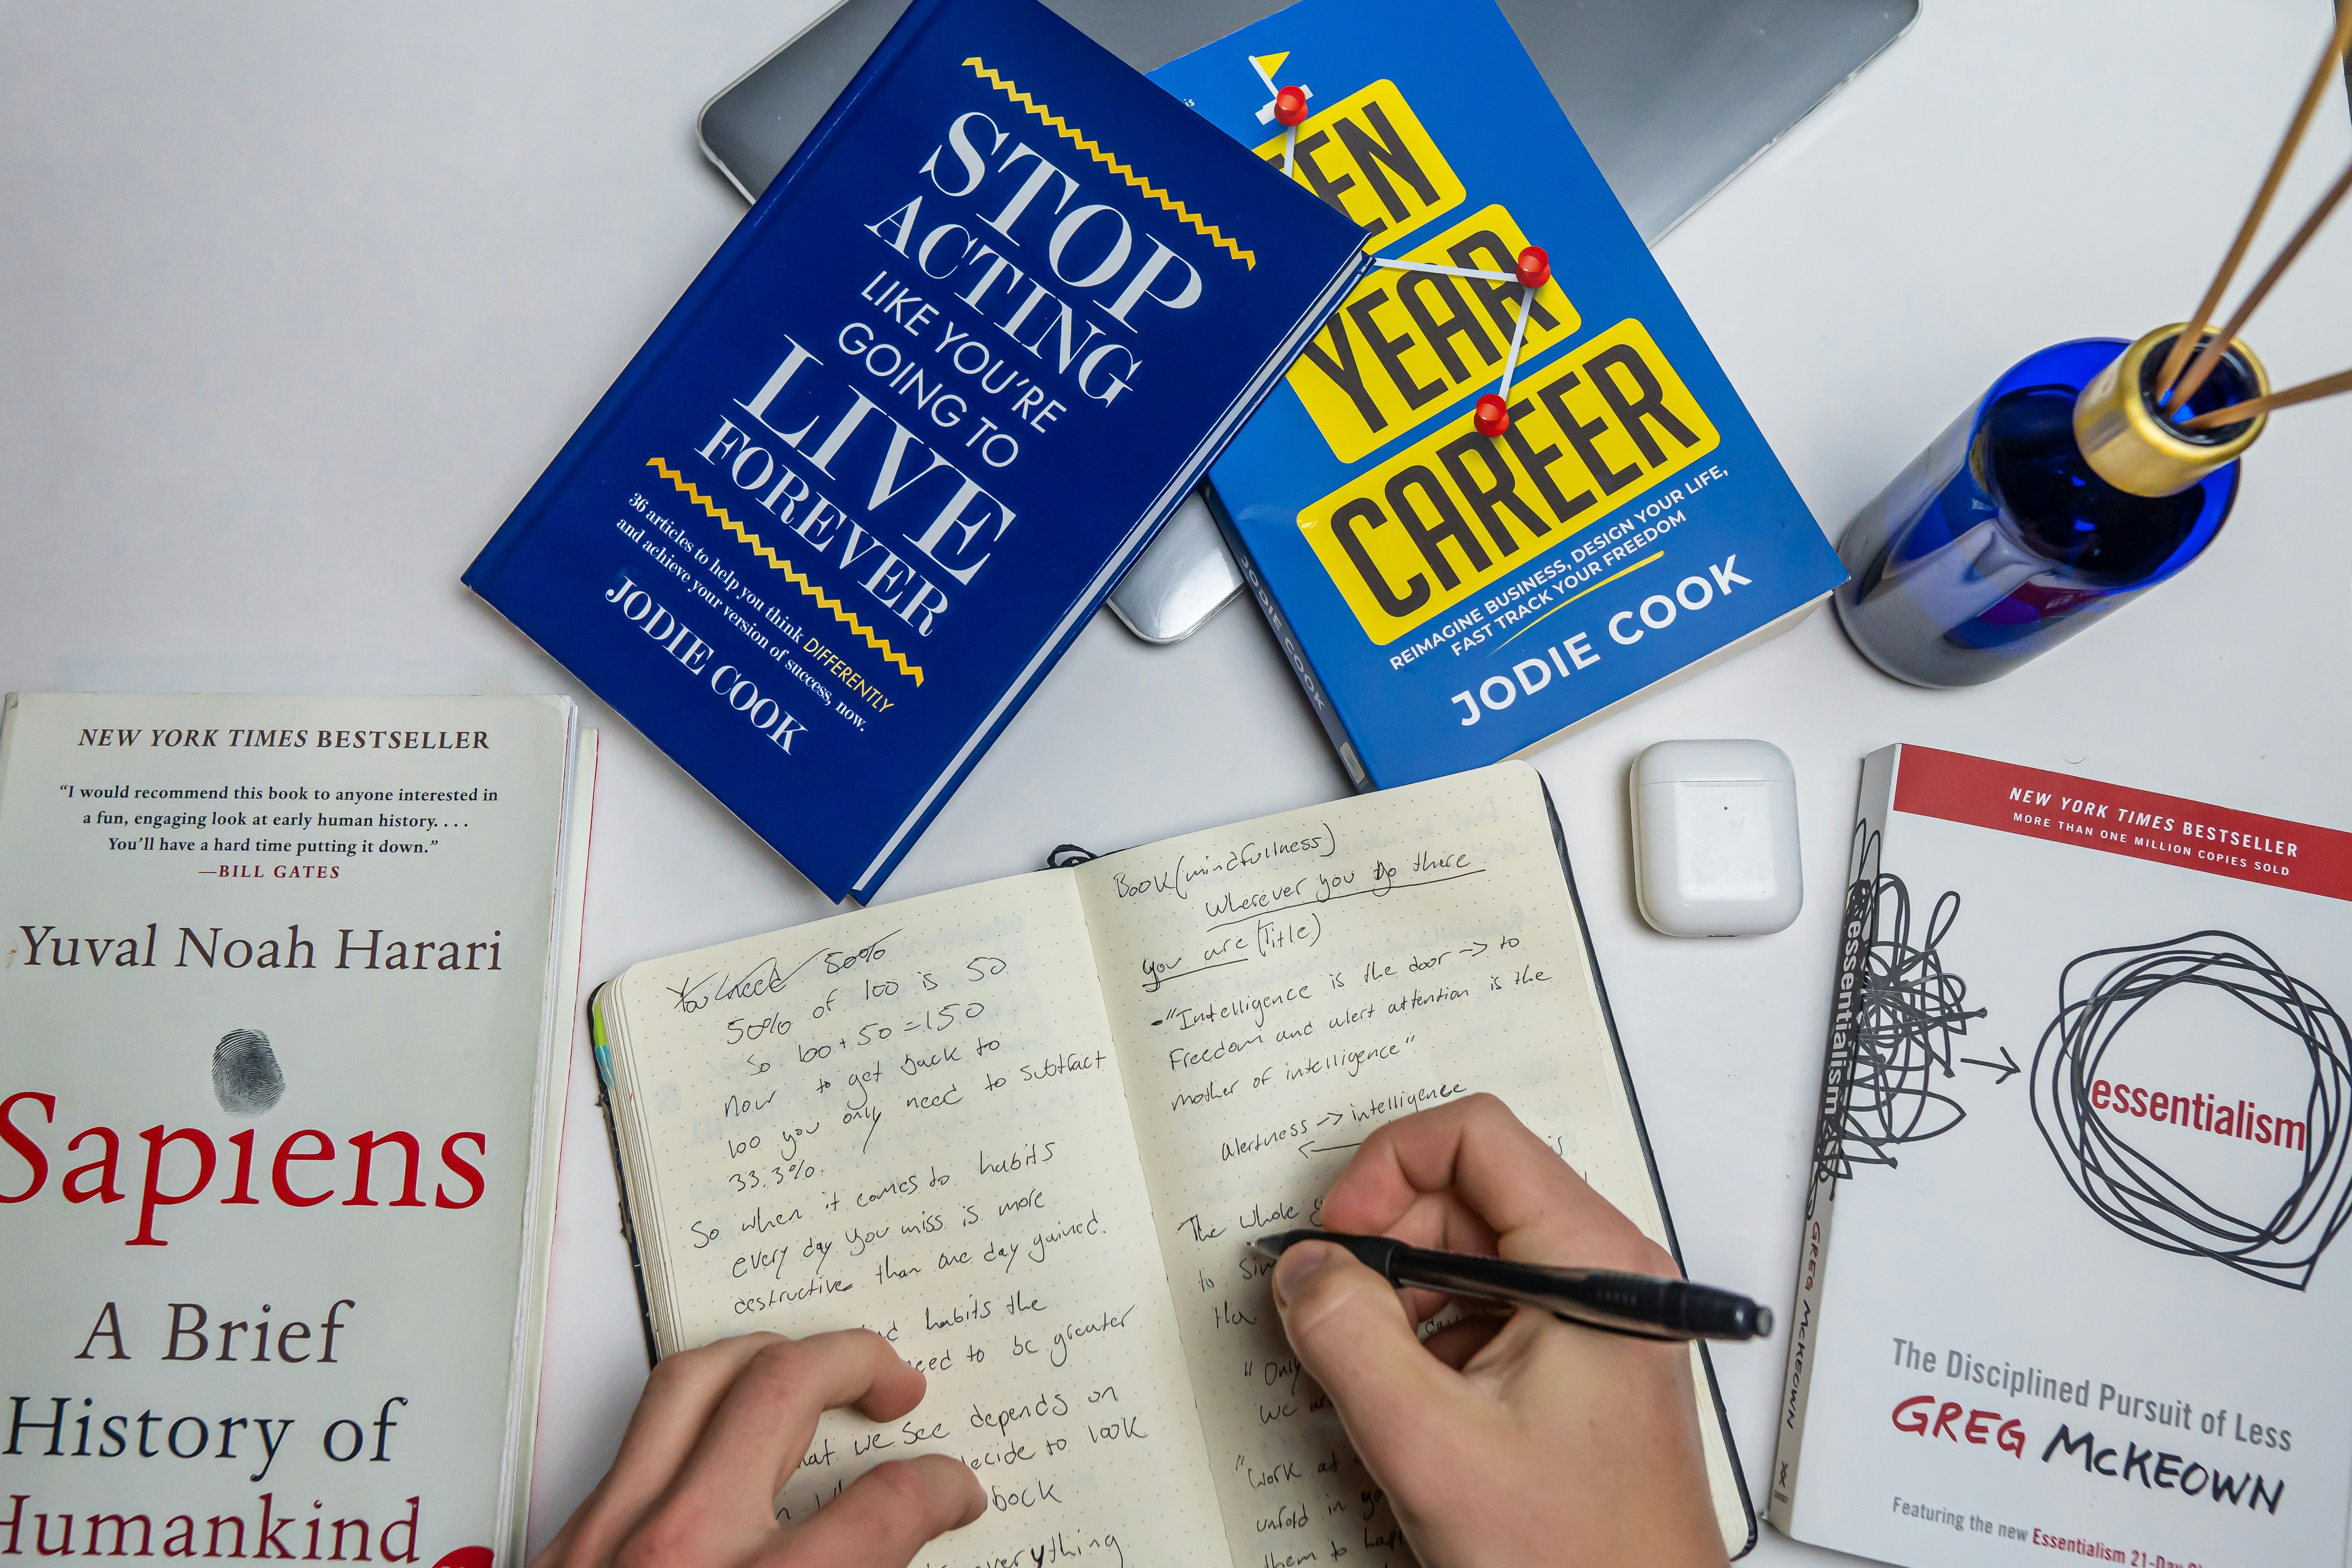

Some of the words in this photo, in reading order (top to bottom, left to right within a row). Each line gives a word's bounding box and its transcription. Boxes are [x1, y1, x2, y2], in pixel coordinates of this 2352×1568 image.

[919, 112, 1202, 334] STOP
[1267, 101, 1441, 237] EN
[861, 270, 940, 337] LIKE
[934, 321, 1067, 434] YOU'RE
[864, 196, 1142, 408] ACTING
[1304, 230, 1561, 433] YEAR
[733, 334, 1016, 586] LIVE
[839, 322, 967, 427] GOING
[965, 416, 1018, 467] TO
[694, 414, 948, 636] FOREVER
[1330, 343, 1702, 618] CAREER
[617, 519, 646, 543] and
[642, 541, 691, 582] achieve
[687, 579, 723, 609] your
[723, 606, 768, 650] version
[770, 647, 789, 662] of
[785, 659, 832, 706] success,
[835, 701, 866, 732] now.
[629, 493, 649, 512] 36
[646, 510, 694, 552] articles
[694, 547, 709, 564] to
[709, 558, 739, 592] help
[736, 587, 764, 612] you
[765, 606, 804, 644] think
[803, 637, 894, 712] DIFFERENTLY
[1241, 555, 1282, 631] JODIE
[1285, 636, 1325, 711] COOK
[1389, 608, 1484, 670] REIMAGINE
[1484, 560, 1572, 614] BUSINESS,
[1570, 519, 1635, 563] DESIGN
[1633, 489, 1685, 523] YOUR
[1684, 465, 1728, 495] LIFE,
[1451, 623, 1493, 657] FAST
[1494, 589, 1554, 629] TRACK
[1551, 561, 1603, 594] YOUR
[1602, 510, 1687, 566] FREEDOM
[1451, 631, 1601, 726] JODIE
[1608, 554, 1752, 645] COOK
[605, 576, 715, 675] JODIE
[712, 665, 808, 755] COOK
[77, 729, 143, 747] NEW
[150, 729, 220, 747] YORK
[229, 729, 308, 747] TIMES
[316, 730, 489, 750] BESTSELLER
[79, 785, 129, 798] would
[134, 785, 228, 799] recommend
[234, 785, 263, 800] this
[269, 786, 308, 800] book
[314, 789, 330, 800] to
[335, 791, 393, 805] anyone
[398, 788, 478, 801] interested
[482, 788, 498, 801] in
[83, 815, 91, 824] a
[96, 810, 128, 827] fun,
[134, 812, 208, 829] engaging
[211, 811, 247, 825] look
[252, 815, 268, 825] at
[273, 812, 313, 830] early
[317, 812, 373, 826] human
[158, 837, 195, 851] have
[200, 841, 208, 851] a
[213, 837, 250, 851] hard
[255, 838, 292, 852] time
[296, 839, 357, 857] putting
[361, 840, 374, 853] it
[274, 865, 340, 879] GATES
[2009, 787, 2052, 806] NEW
[2061, 797, 2109, 818] YORK
[2118, 808, 2175, 831] TIMES
[2183, 821, 2297, 857] BESTSELLER
[2013, 812, 2051, 827] MORE
[2058, 821, 2093, 836] THAN
[2100, 830, 2127, 843] ONE
[2134, 836, 2191, 856] MILLION
[2198, 850, 2247, 867] COPIES
[2254, 862, 2289, 876] SOLD
[19, 923, 157, 967] Yuval
[173, 924, 316, 968] Noah
[334, 929, 502, 970] Harari
[1825, 920, 1862, 1114] essentialism
[0, 1091, 486, 1246] Sapiens
[2092, 1080, 2306, 1151] essentialism
[73, 1301, 132, 1360] A
[161, 1299, 356, 1363] Brief
[1892, 1337, 1937, 1373] The
[1946, 1349, 2091, 1408] Disciplined
[2098, 1383, 2193, 1431] Pursuit
[2200, 1408, 2227, 1438] of
[2234, 1412, 2292, 1452] Less
[1, 1395, 296, 1483] History
[323, 1396, 408, 1462] of
[1892, 1395, 2026, 1459] GREG
[1892, 1496, 1965, 1532] Featuring
[1969, 1514, 1993, 1535] the
[1998, 1524, 2028, 1542] new
[2032, 1527, 2126, 1565] Essentialism
